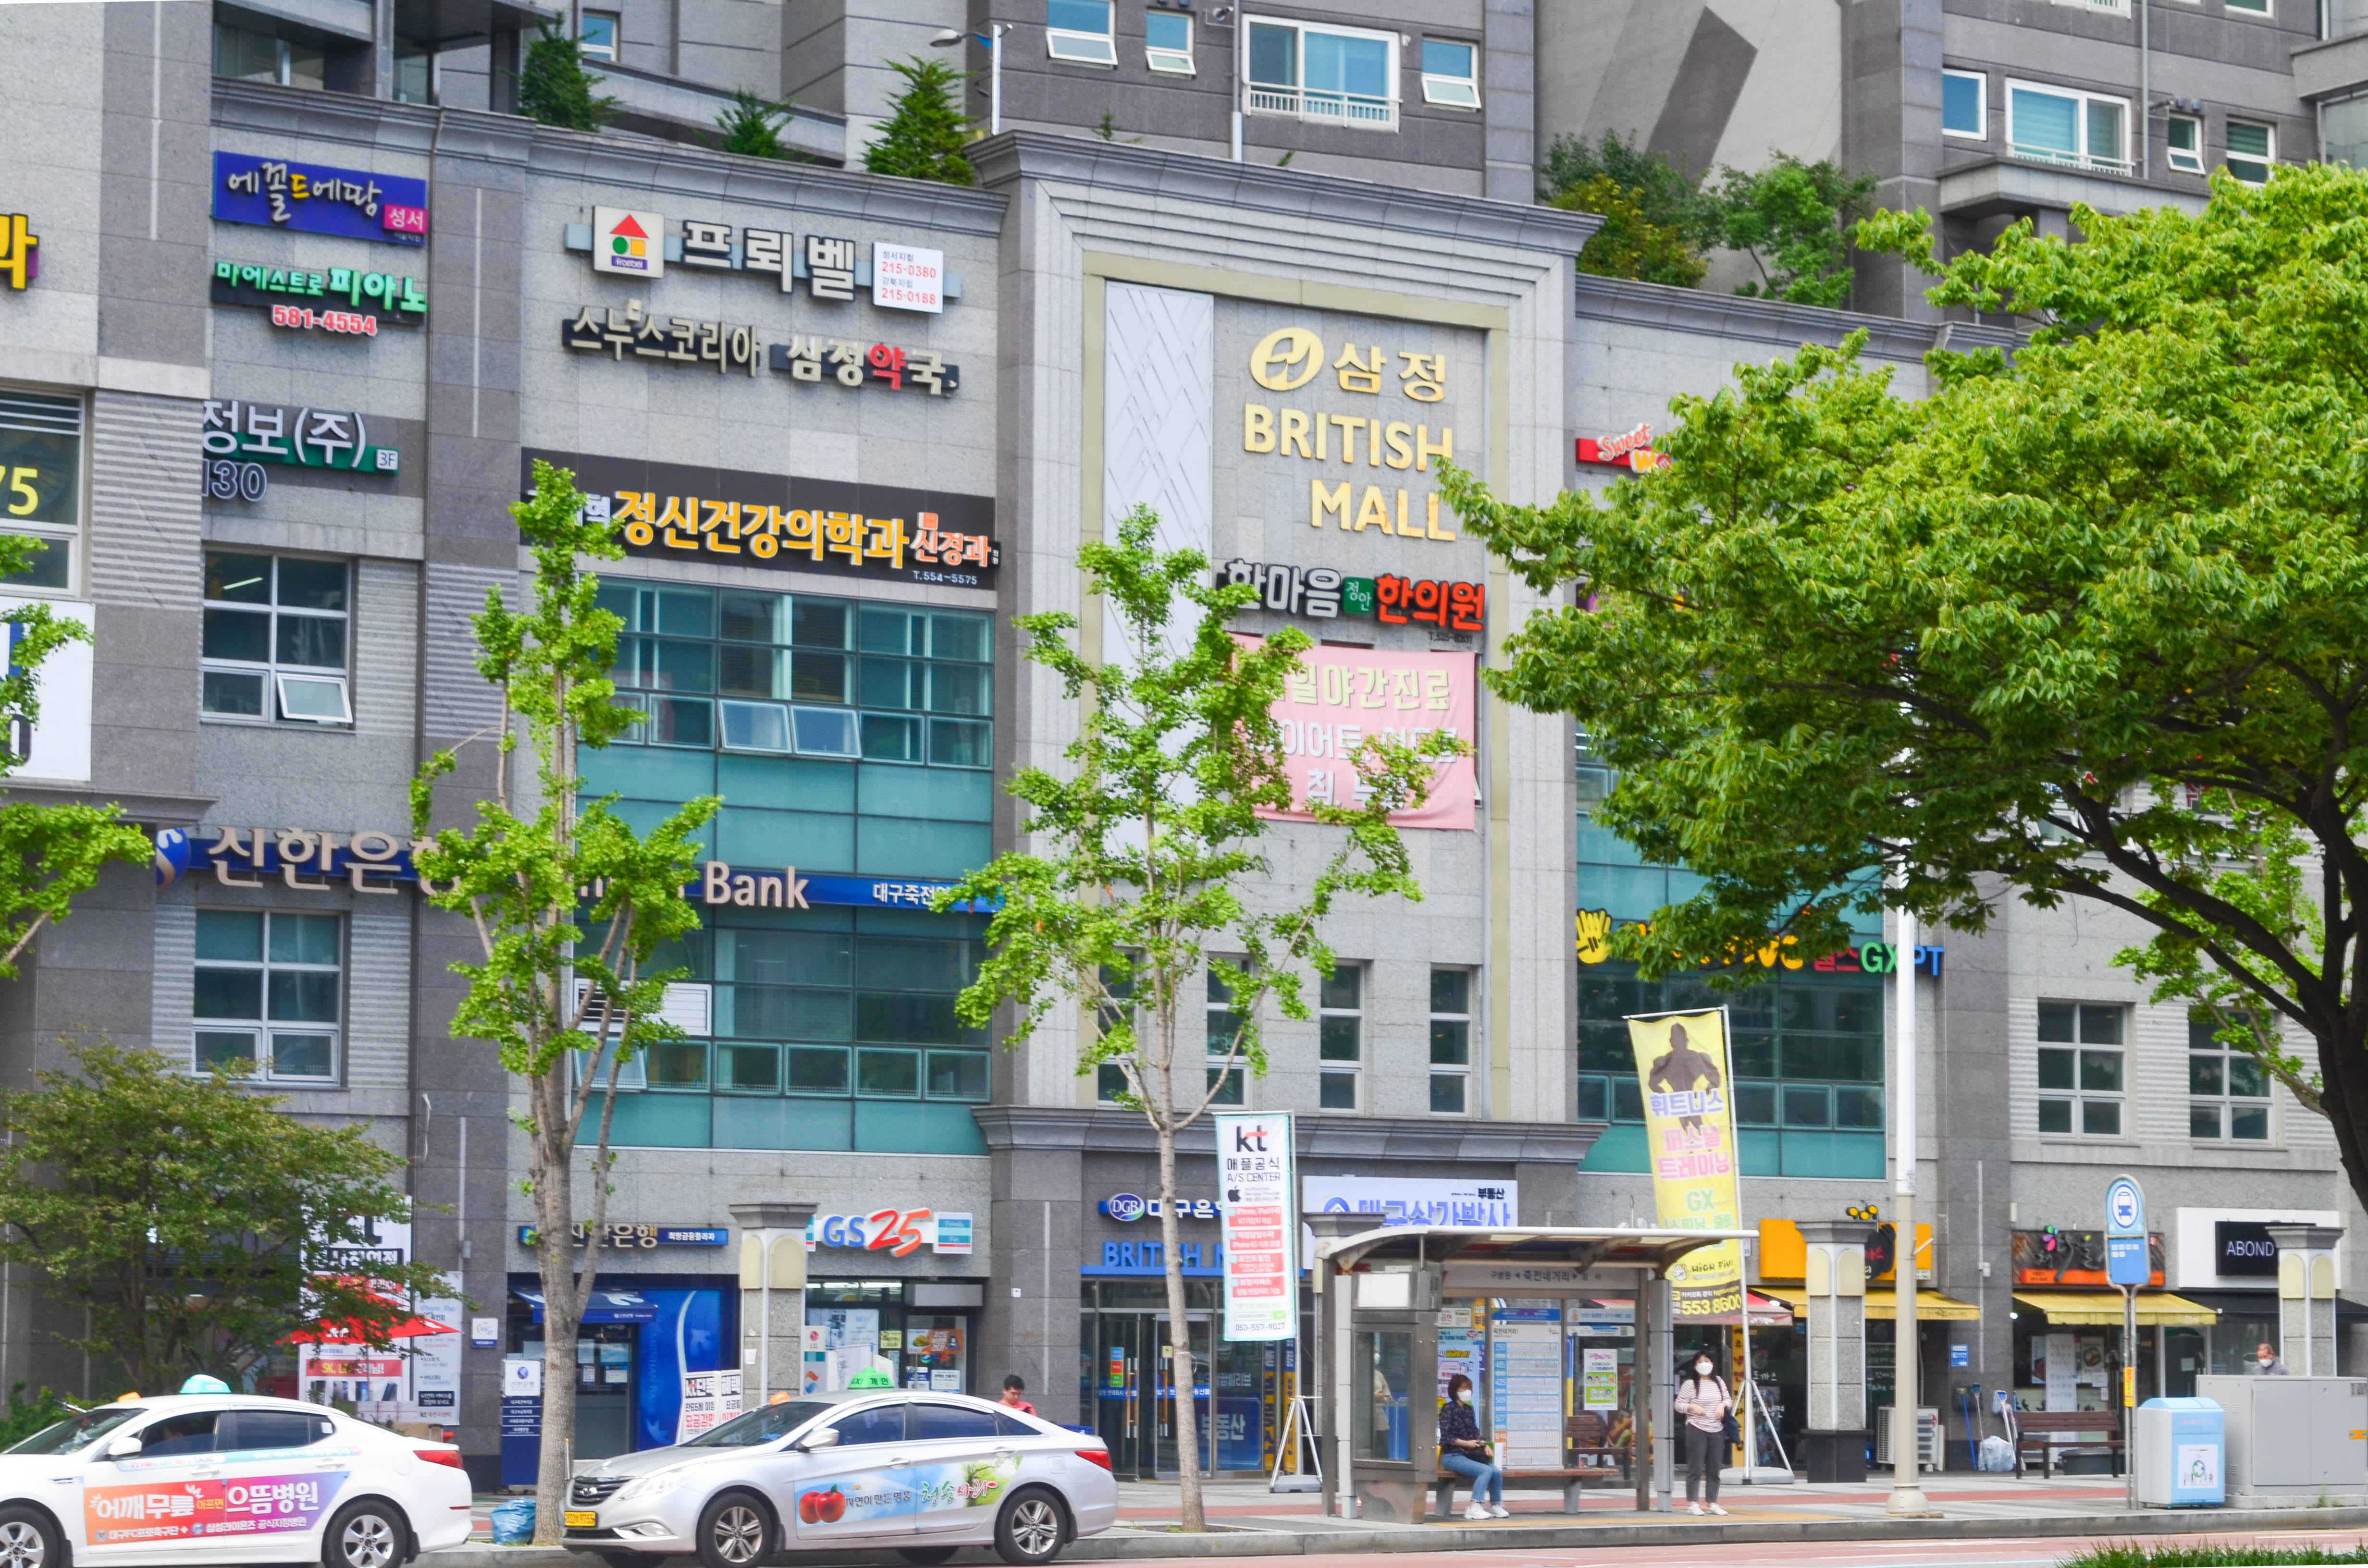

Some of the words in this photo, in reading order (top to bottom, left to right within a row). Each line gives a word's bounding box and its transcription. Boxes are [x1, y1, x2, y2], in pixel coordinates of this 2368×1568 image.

[389, 207, 423, 231] 성서
[684, 220, 855, 300] 프뢰벨
[882, 261, 936, 279] 215-0380
[216, 262, 324, 296] 마에스트로
[328, 267, 427, 313] 피아노
[882, 287, 936, 305] 215-0188
[271, 304, 377, 337] 581-4554
[787, 335, 946, 396] 삼정약국
[1333, 342, 1445, 403] 삼정
[1244, 403, 1453, 472] BRITISH
[1597, 422, 1653, 462] Sweet
[380, 452, 396, 467] 3F
[1310, 479, 1456, 542] MALL
[612, 490, 910, 570] 정신건강의학과
[909, 529, 992, 568] 신경과
[912, 570, 977, 585] T.554-5575
[1376, 573, 1485, 632] 한의원
[704, 860, 810, 910] Bank
[1235, 1125, 1269, 1152] kt
[1227, 1173, 1244, 1182] A/S
[1246, 1172, 1281, 1182] CENTER
[1657, 1151, 1730, 1180] 트레이닝
[1112, 1199, 1138, 1213] DGB
[1478, 1188, 1505, 1200] 부동산
[1685, 1188, 1717, 1213] GX
[822, 1208, 932, 1258] GS25
[1523, 1270, 1570, 1282] 죽전네거리
[1681, 1299, 1711, 1315] 553
[1712, 1293, 1742, 1314] 8600
[870, 1377, 889, 1385] 개인
[97, 1496, 144, 1519] 어깨
[146, 1493, 194, 1519] 무릎
[197, 1498, 223, 1510] 아프면
[226, 1481, 320, 1515] 으뜸병원
[845, 1496, 872, 1507] 자연이
[874, 1493, 892, 1504] 만든
[893, 1491, 911, 1502] 명품
